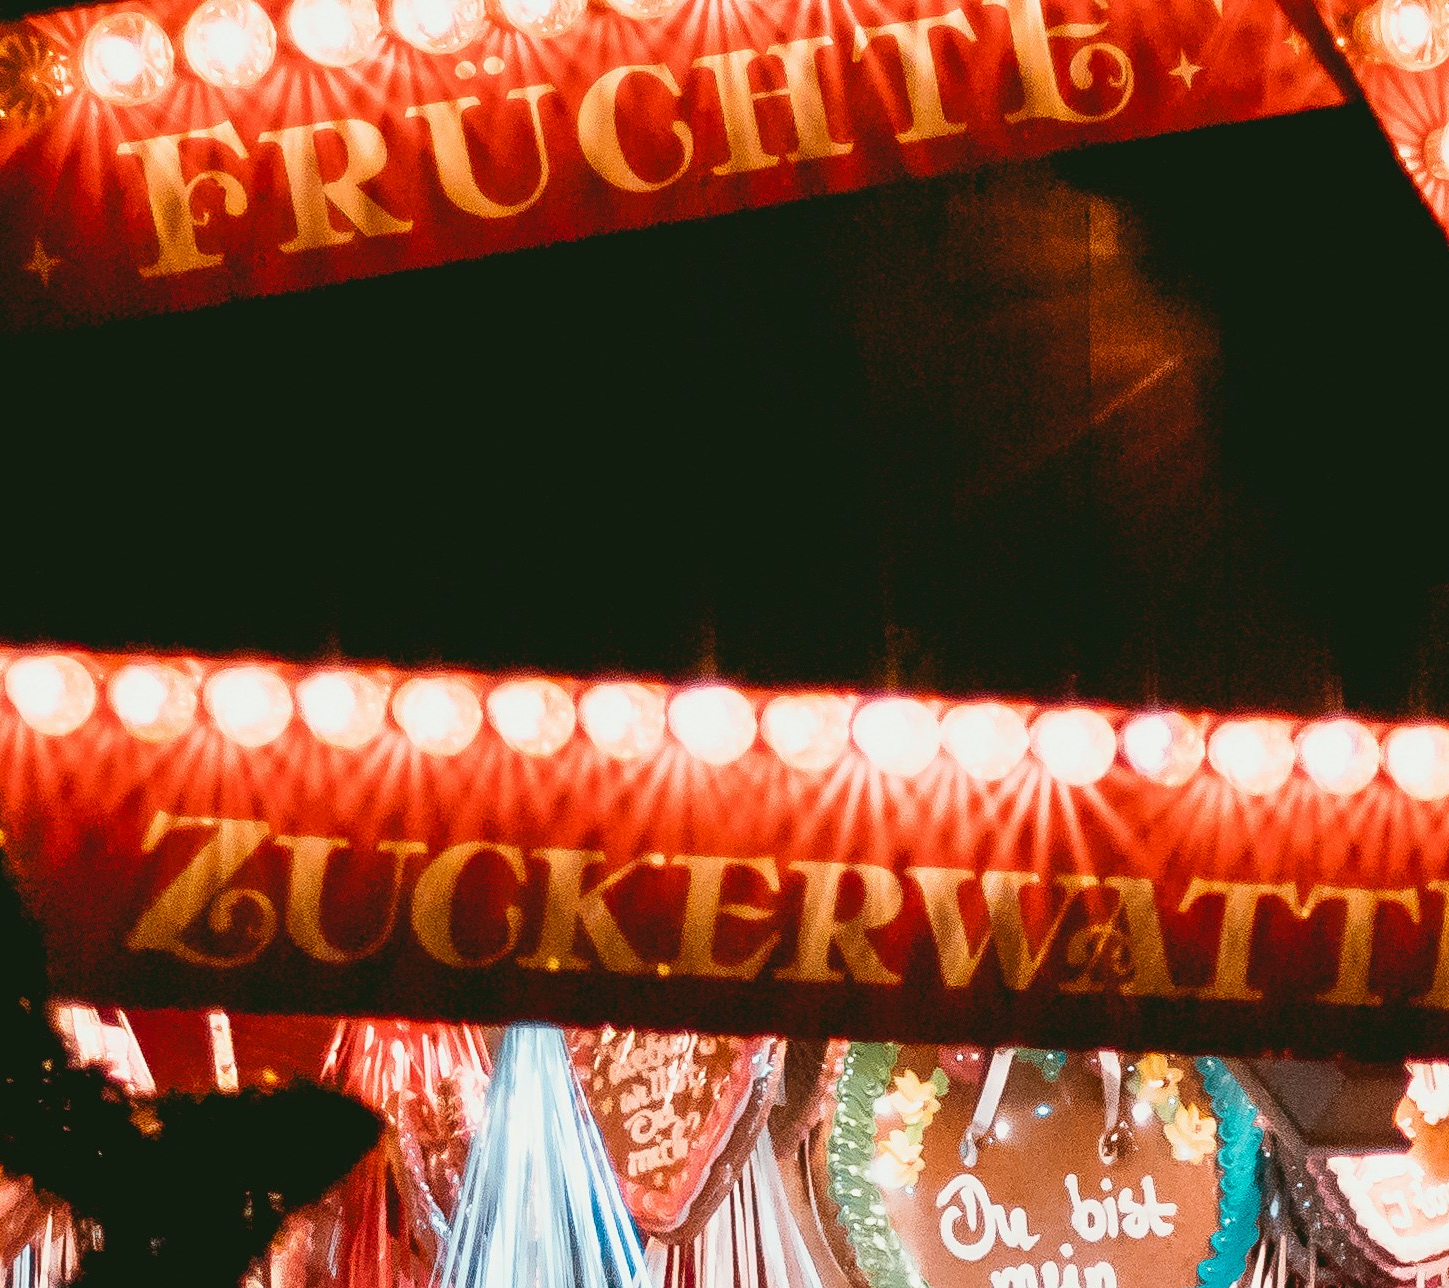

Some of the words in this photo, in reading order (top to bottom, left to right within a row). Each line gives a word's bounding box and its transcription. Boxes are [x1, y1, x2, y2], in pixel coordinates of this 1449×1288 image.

[117, 0, 1135, 280] FRÜCHTE
[936, 1174, 1039, 1260] Du
[1066, 1174, 1177, 1241] bist
